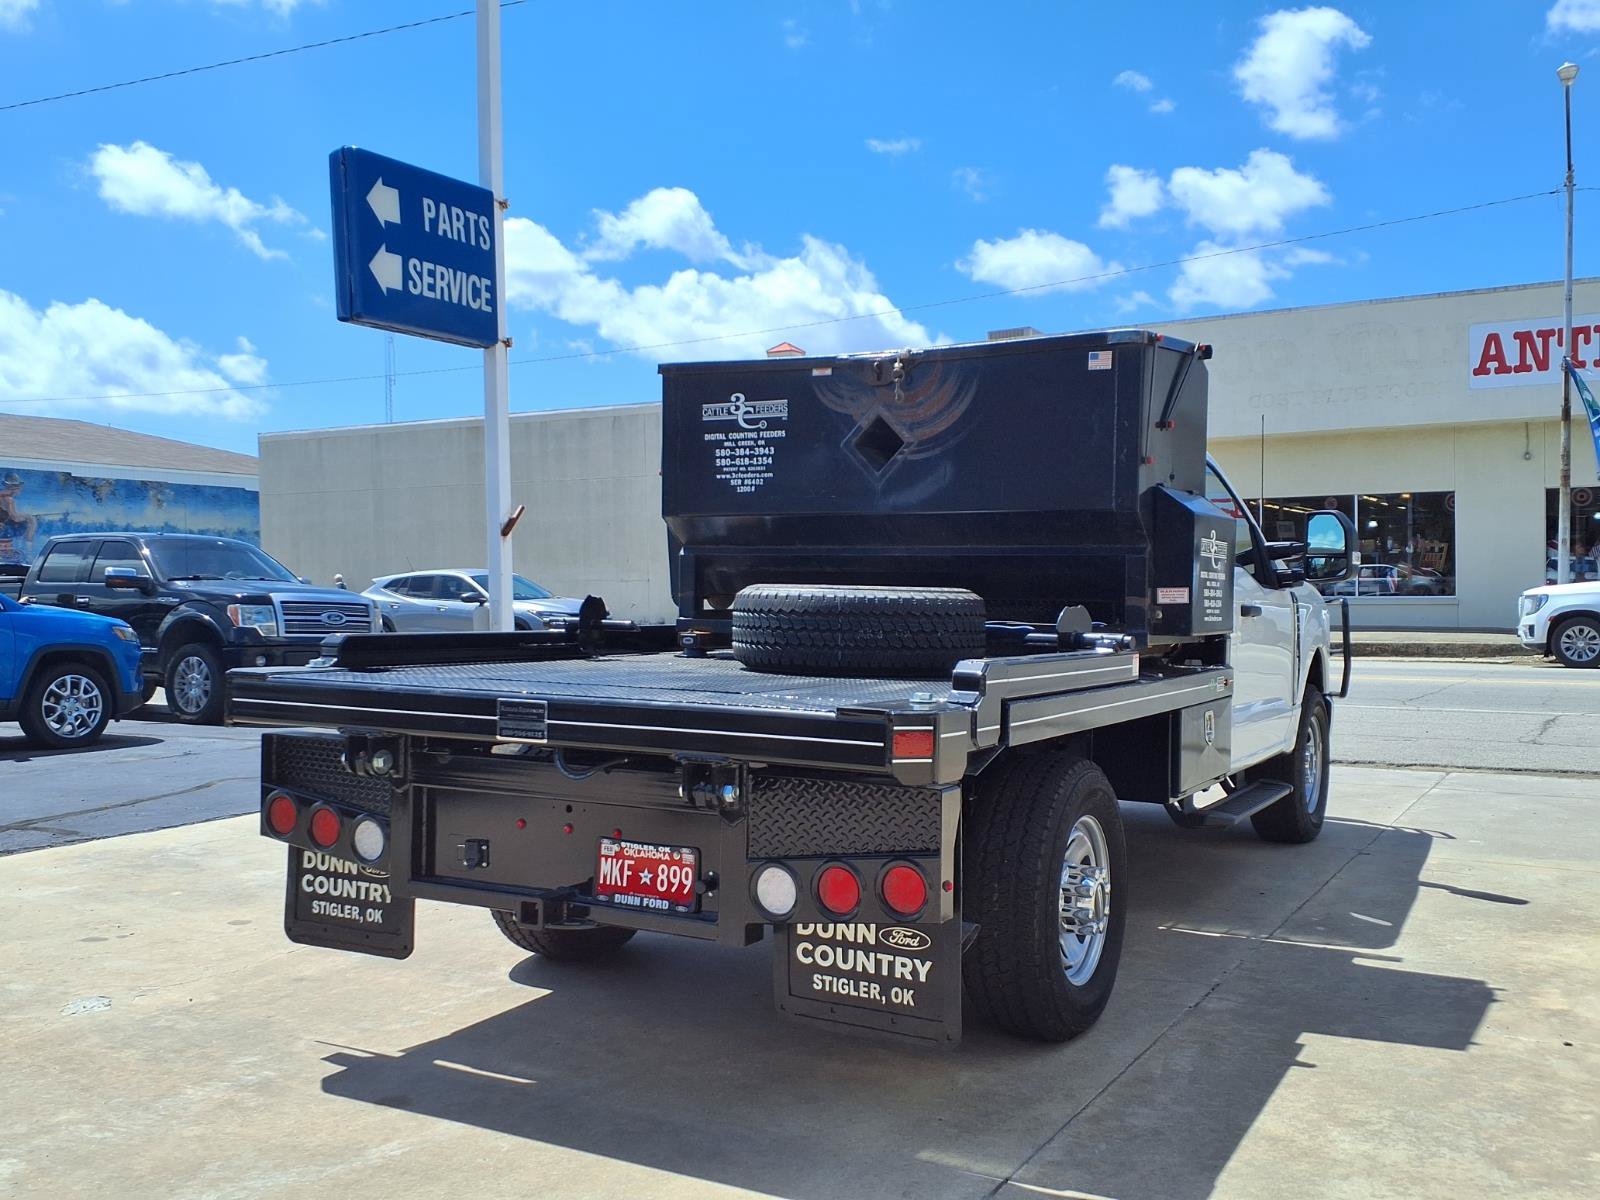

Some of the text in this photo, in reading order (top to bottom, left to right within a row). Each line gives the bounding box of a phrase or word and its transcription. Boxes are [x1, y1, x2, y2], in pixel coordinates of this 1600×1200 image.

[422, 197, 491, 251] PARTS
[408, 258, 492, 312] SERVICE
[702, 407, 728, 416] CATTLE
[755, 403, 788, 414] FEEDERS
[704, 430, 786, 441] DIGITAL COUNTING FEEDERS
[715, 447, 775, 457] 580-384-3943
[715, 456, 773, 466] 580-618-1354
[302, 850, 358, 875] DUNN
[624, 848, 670, 861] OKLAHOMA
[599, 857, 693, 895] MKF 899
[301, 874, 392, 904] COUNTRY
[312, 900, 383, 924] STIGLER, OK
[614, 894, 641, 906] DUNN
[643, 897, 669, 910] FORD
[889, 929, 920, 947] Ford
[796, 942, 933, 983] COUNTRY
[813, 973, 915, 1007] STIGLER, OK
